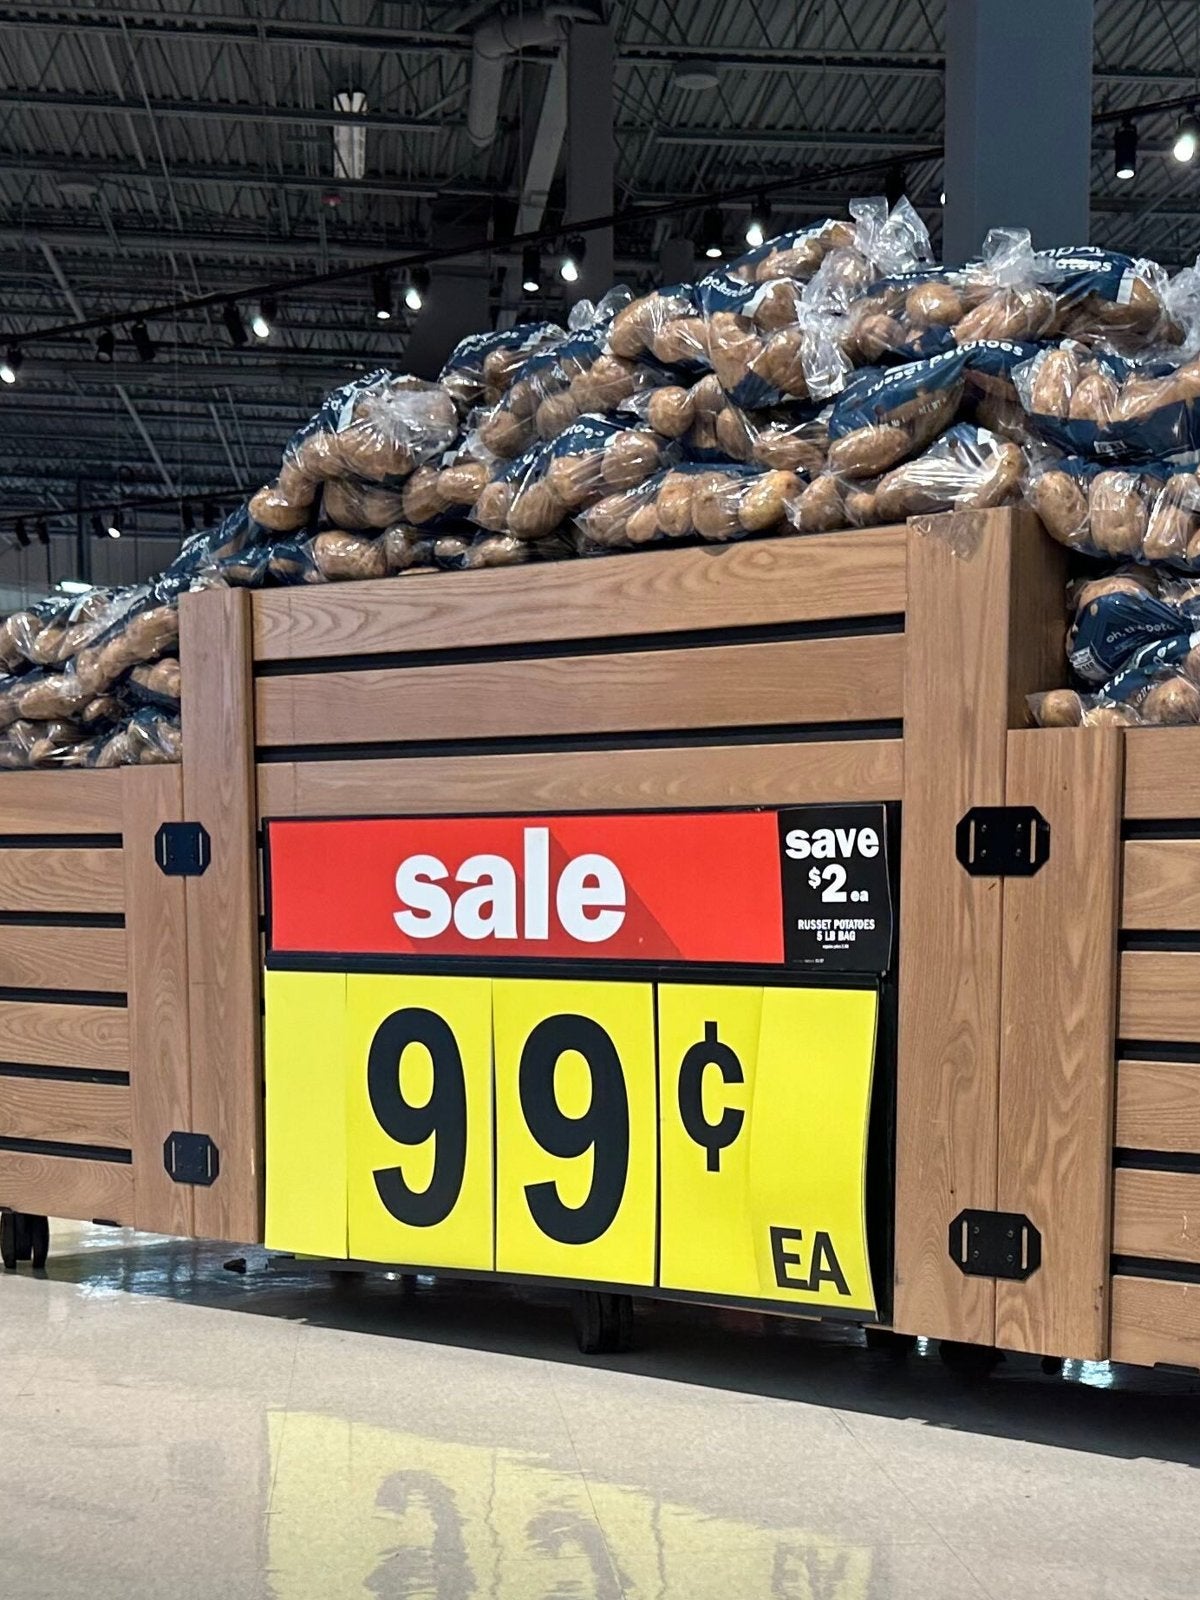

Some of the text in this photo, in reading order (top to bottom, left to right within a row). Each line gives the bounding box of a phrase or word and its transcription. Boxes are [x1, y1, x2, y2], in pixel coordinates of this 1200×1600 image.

[785, 827, 880, 859] save
[393, 827, 626, 942] sale
[808, 863, 869, 903] $2 ea
[797, 918, 876, 930] RUSSET POTATOES
[816, 930, 856, 941] 5 LB BAG
[769, 1226, 850, 1296] EA
